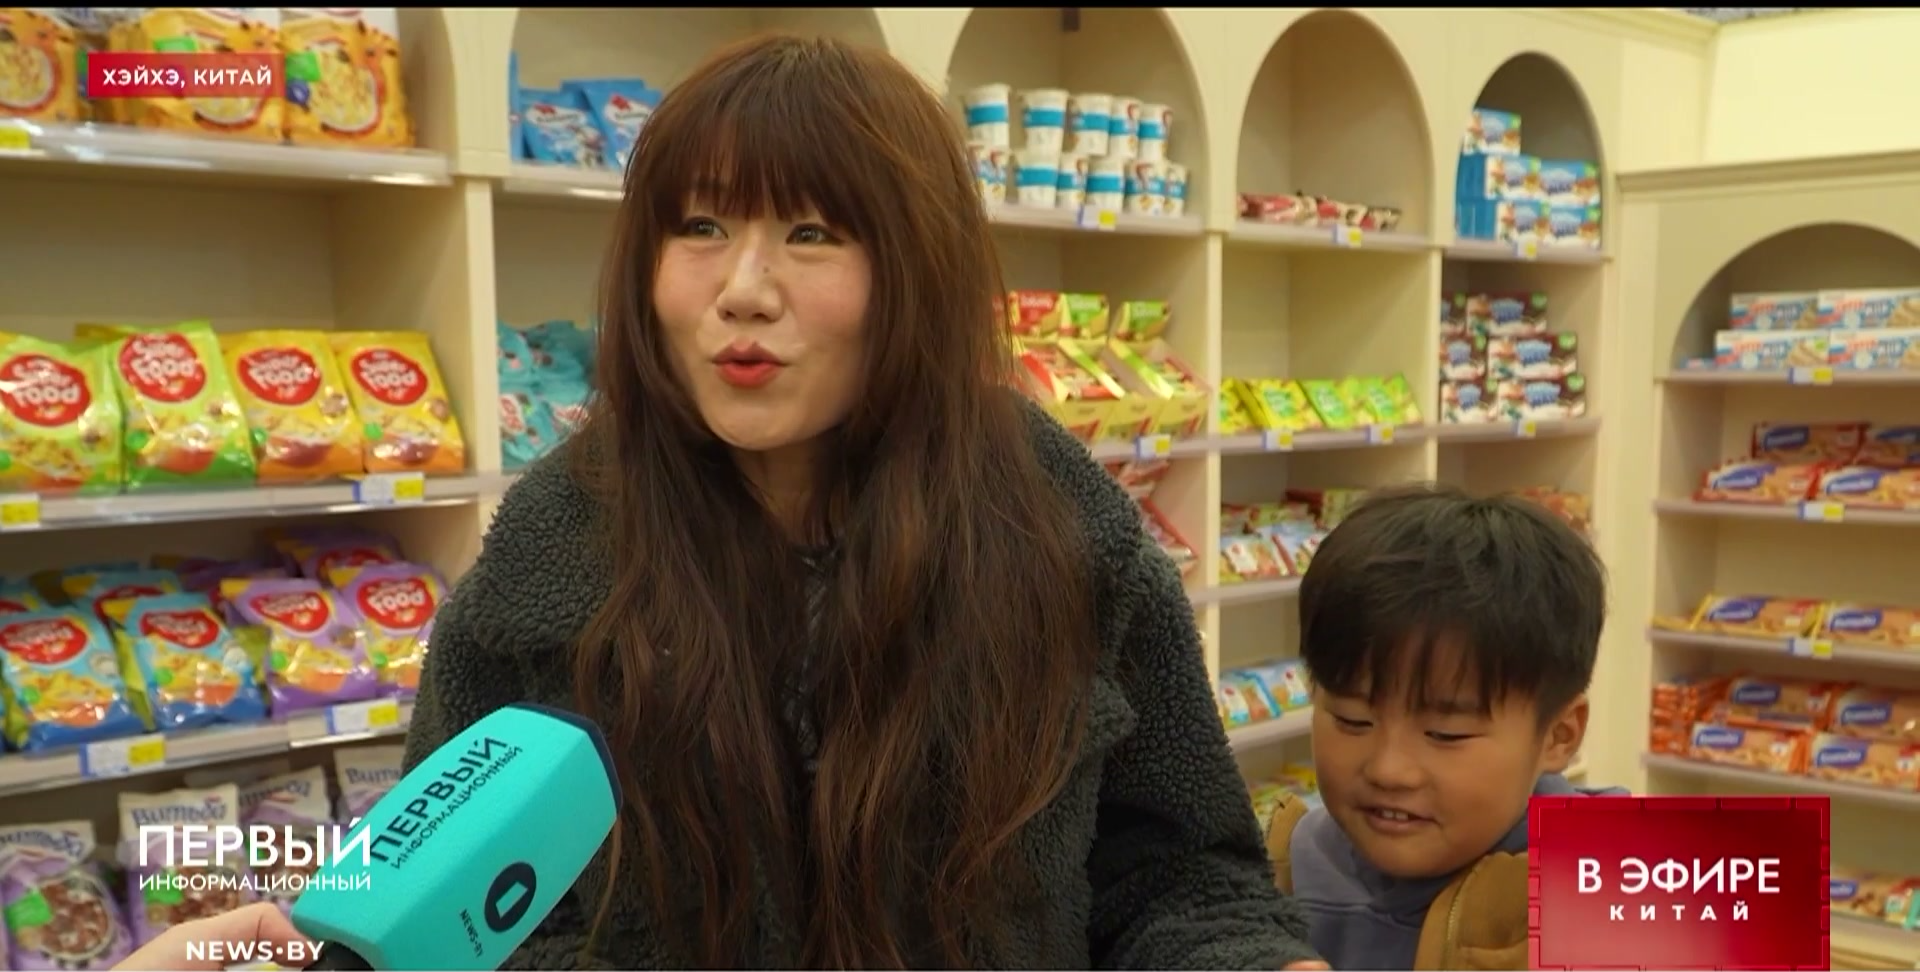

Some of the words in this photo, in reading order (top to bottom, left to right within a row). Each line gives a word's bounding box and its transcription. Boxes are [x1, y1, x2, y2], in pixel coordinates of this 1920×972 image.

[130, 356, 196, 385] Food
[247, 361, 315, 390] Food
[360, 369, 418, 393] Food
[367, 588, 425, 616] Food
[370, 736, 508, 862] ПЕРВЫЙ
[390, 746, 523, 869] ИНФОРМАЦИОННЫЙ
